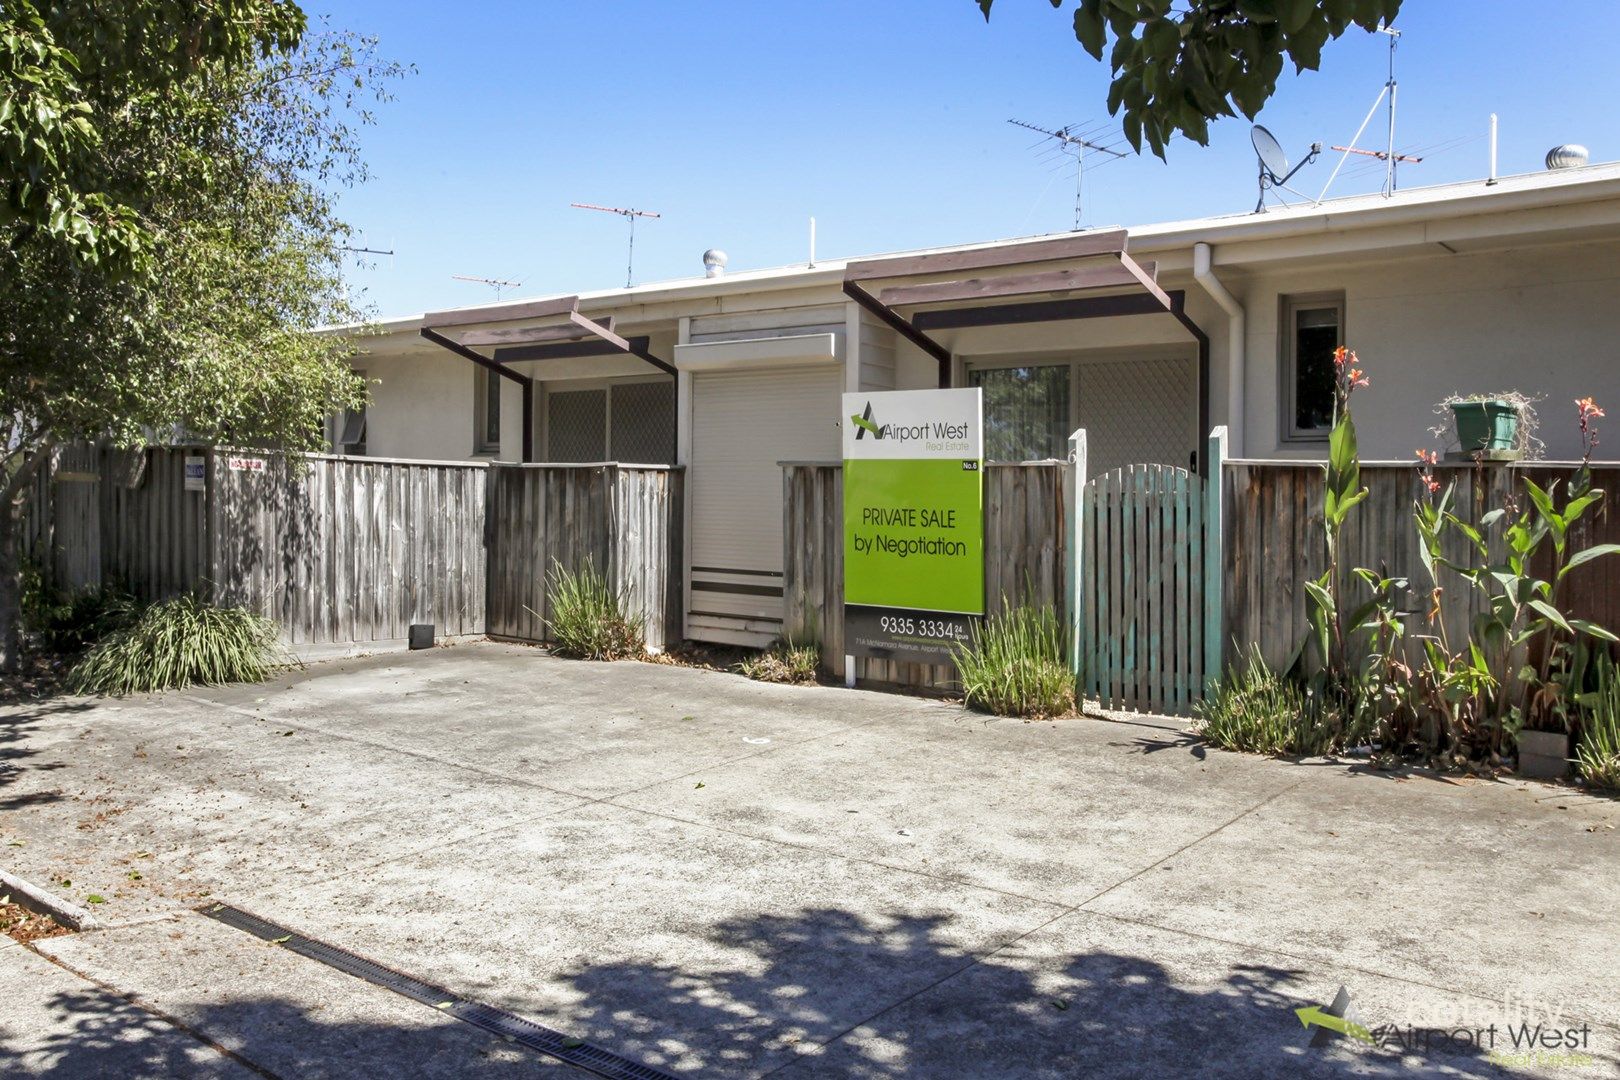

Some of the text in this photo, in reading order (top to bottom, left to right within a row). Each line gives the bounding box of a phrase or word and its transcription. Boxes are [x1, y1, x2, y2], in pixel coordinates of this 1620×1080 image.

[883, 422, 969, 443] Airport West
[925, 442, 970, 451] Real Estate
[963, 462, 977, 470] No.6
[862, 507, 956, 529] PRIVATE SALE
[854, 533, 966, 558] by Negotiation
[880, 616, 954, 638] 9335 3334
[954, 625, 963, 633] 24
